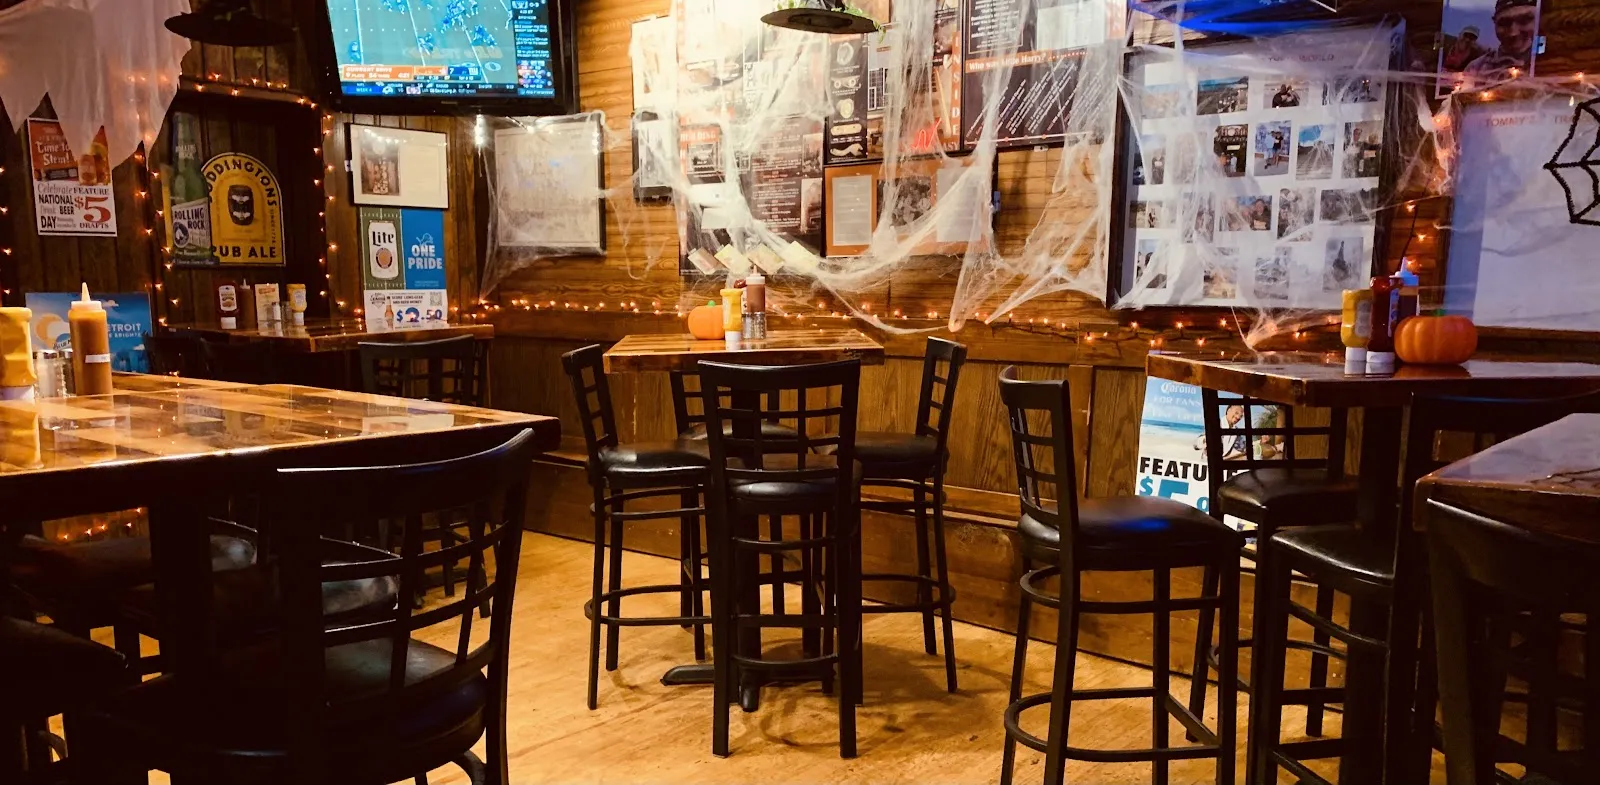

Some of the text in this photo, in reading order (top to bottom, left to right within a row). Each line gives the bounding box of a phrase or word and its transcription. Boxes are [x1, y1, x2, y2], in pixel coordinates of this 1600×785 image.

[969, 61, 984, 70] Who
[1002, 56, 1019, 66] Little
[1022, 52, 1046, 63] Harry?
[205, 158, 277, 206] ODDINGTONS
[73, 187, 110, 195] FEATURE
[38, 194, 74, 205] NATIONAL
[59, 205, 75, 215] BEER
[74, 196, 111, 224] $5
[174, 207, 205, 220] ROLLING
[40, 215, 57, 229] DAY
[187, 220, 206, 230] ROCK
[372, 231, 394, 246] Lite
[248, 246, 276, 258] ALE
[411, 244, 435, 257] ONE
[407, 257, 443, 270] PRIDE
[107, 323, 141, 331] ETROIT
[1160, 382, 1196, 395] Corona
[1139, 457, 1209, 482] FEATU
